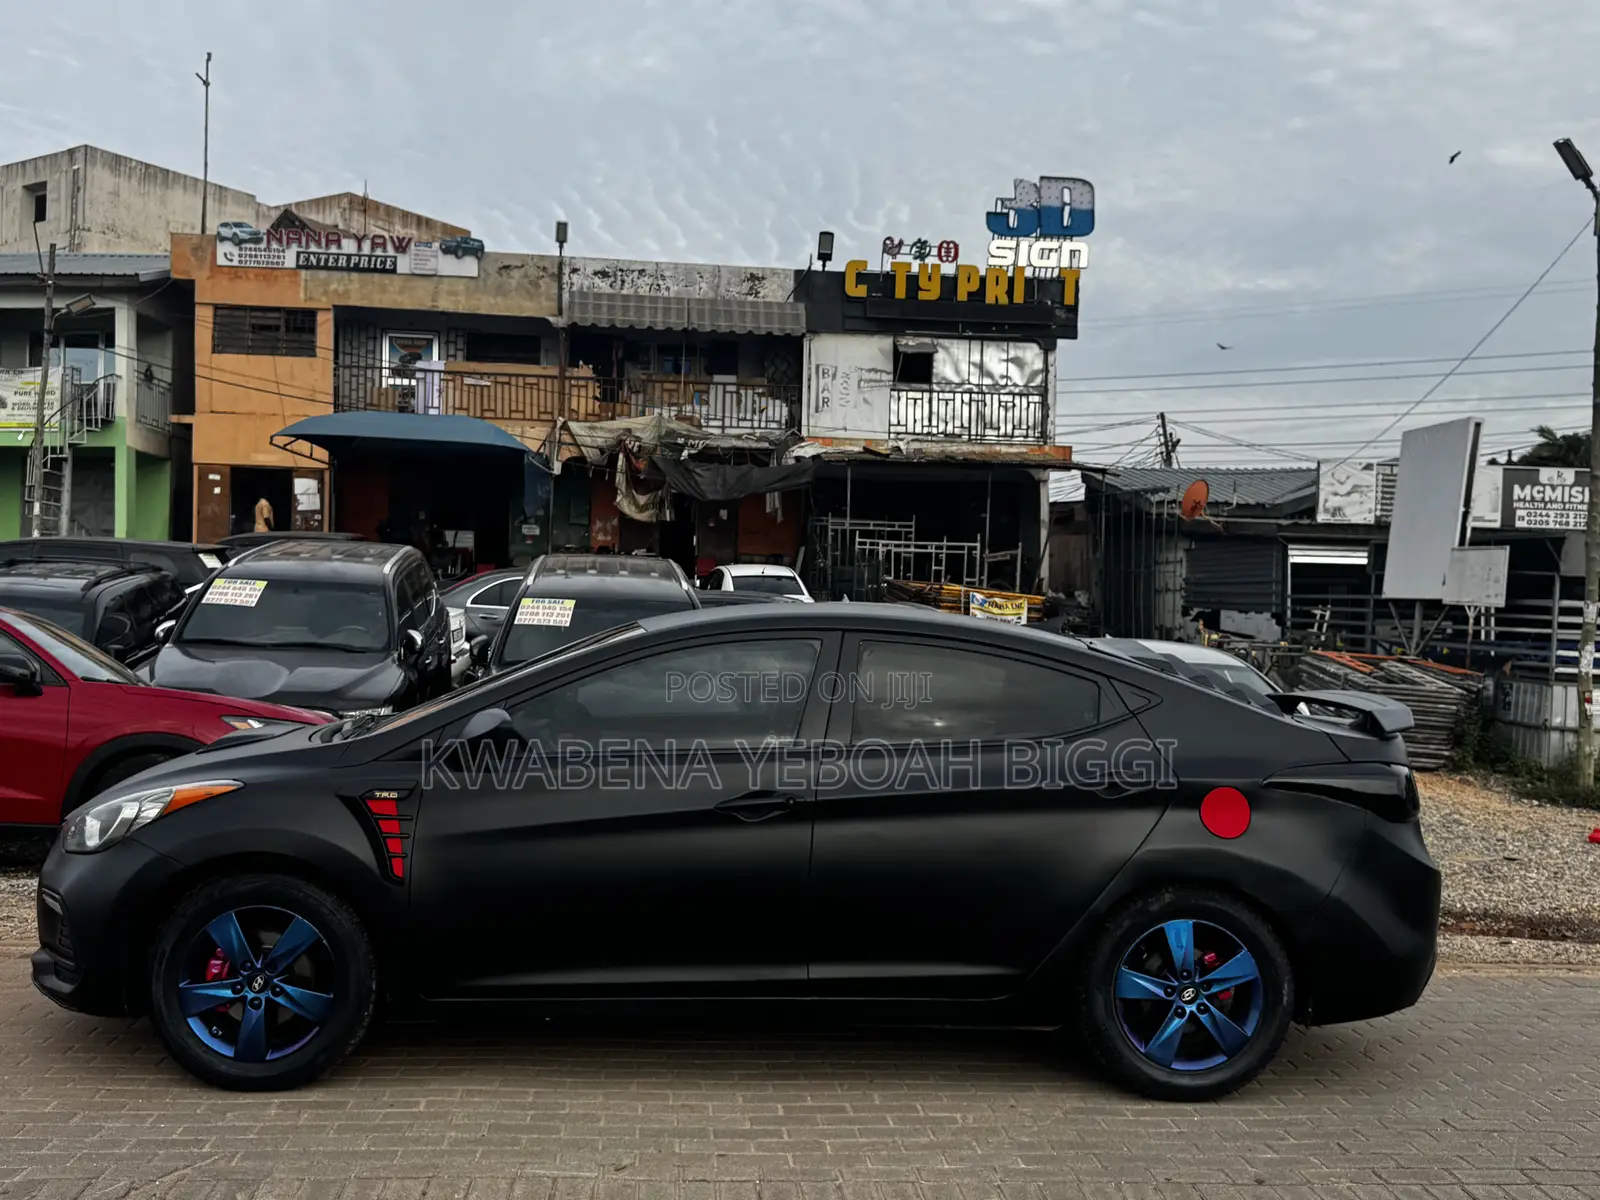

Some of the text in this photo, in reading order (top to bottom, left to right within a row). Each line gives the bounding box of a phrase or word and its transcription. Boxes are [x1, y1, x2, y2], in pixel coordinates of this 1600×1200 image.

[265, 229, 413, 254] NANA YAW
[300, 253, 396, 269] ENTERPRICE
[821, 368, 831, 408] BAR
[1513, 501, 1545, 509] HEALTH
